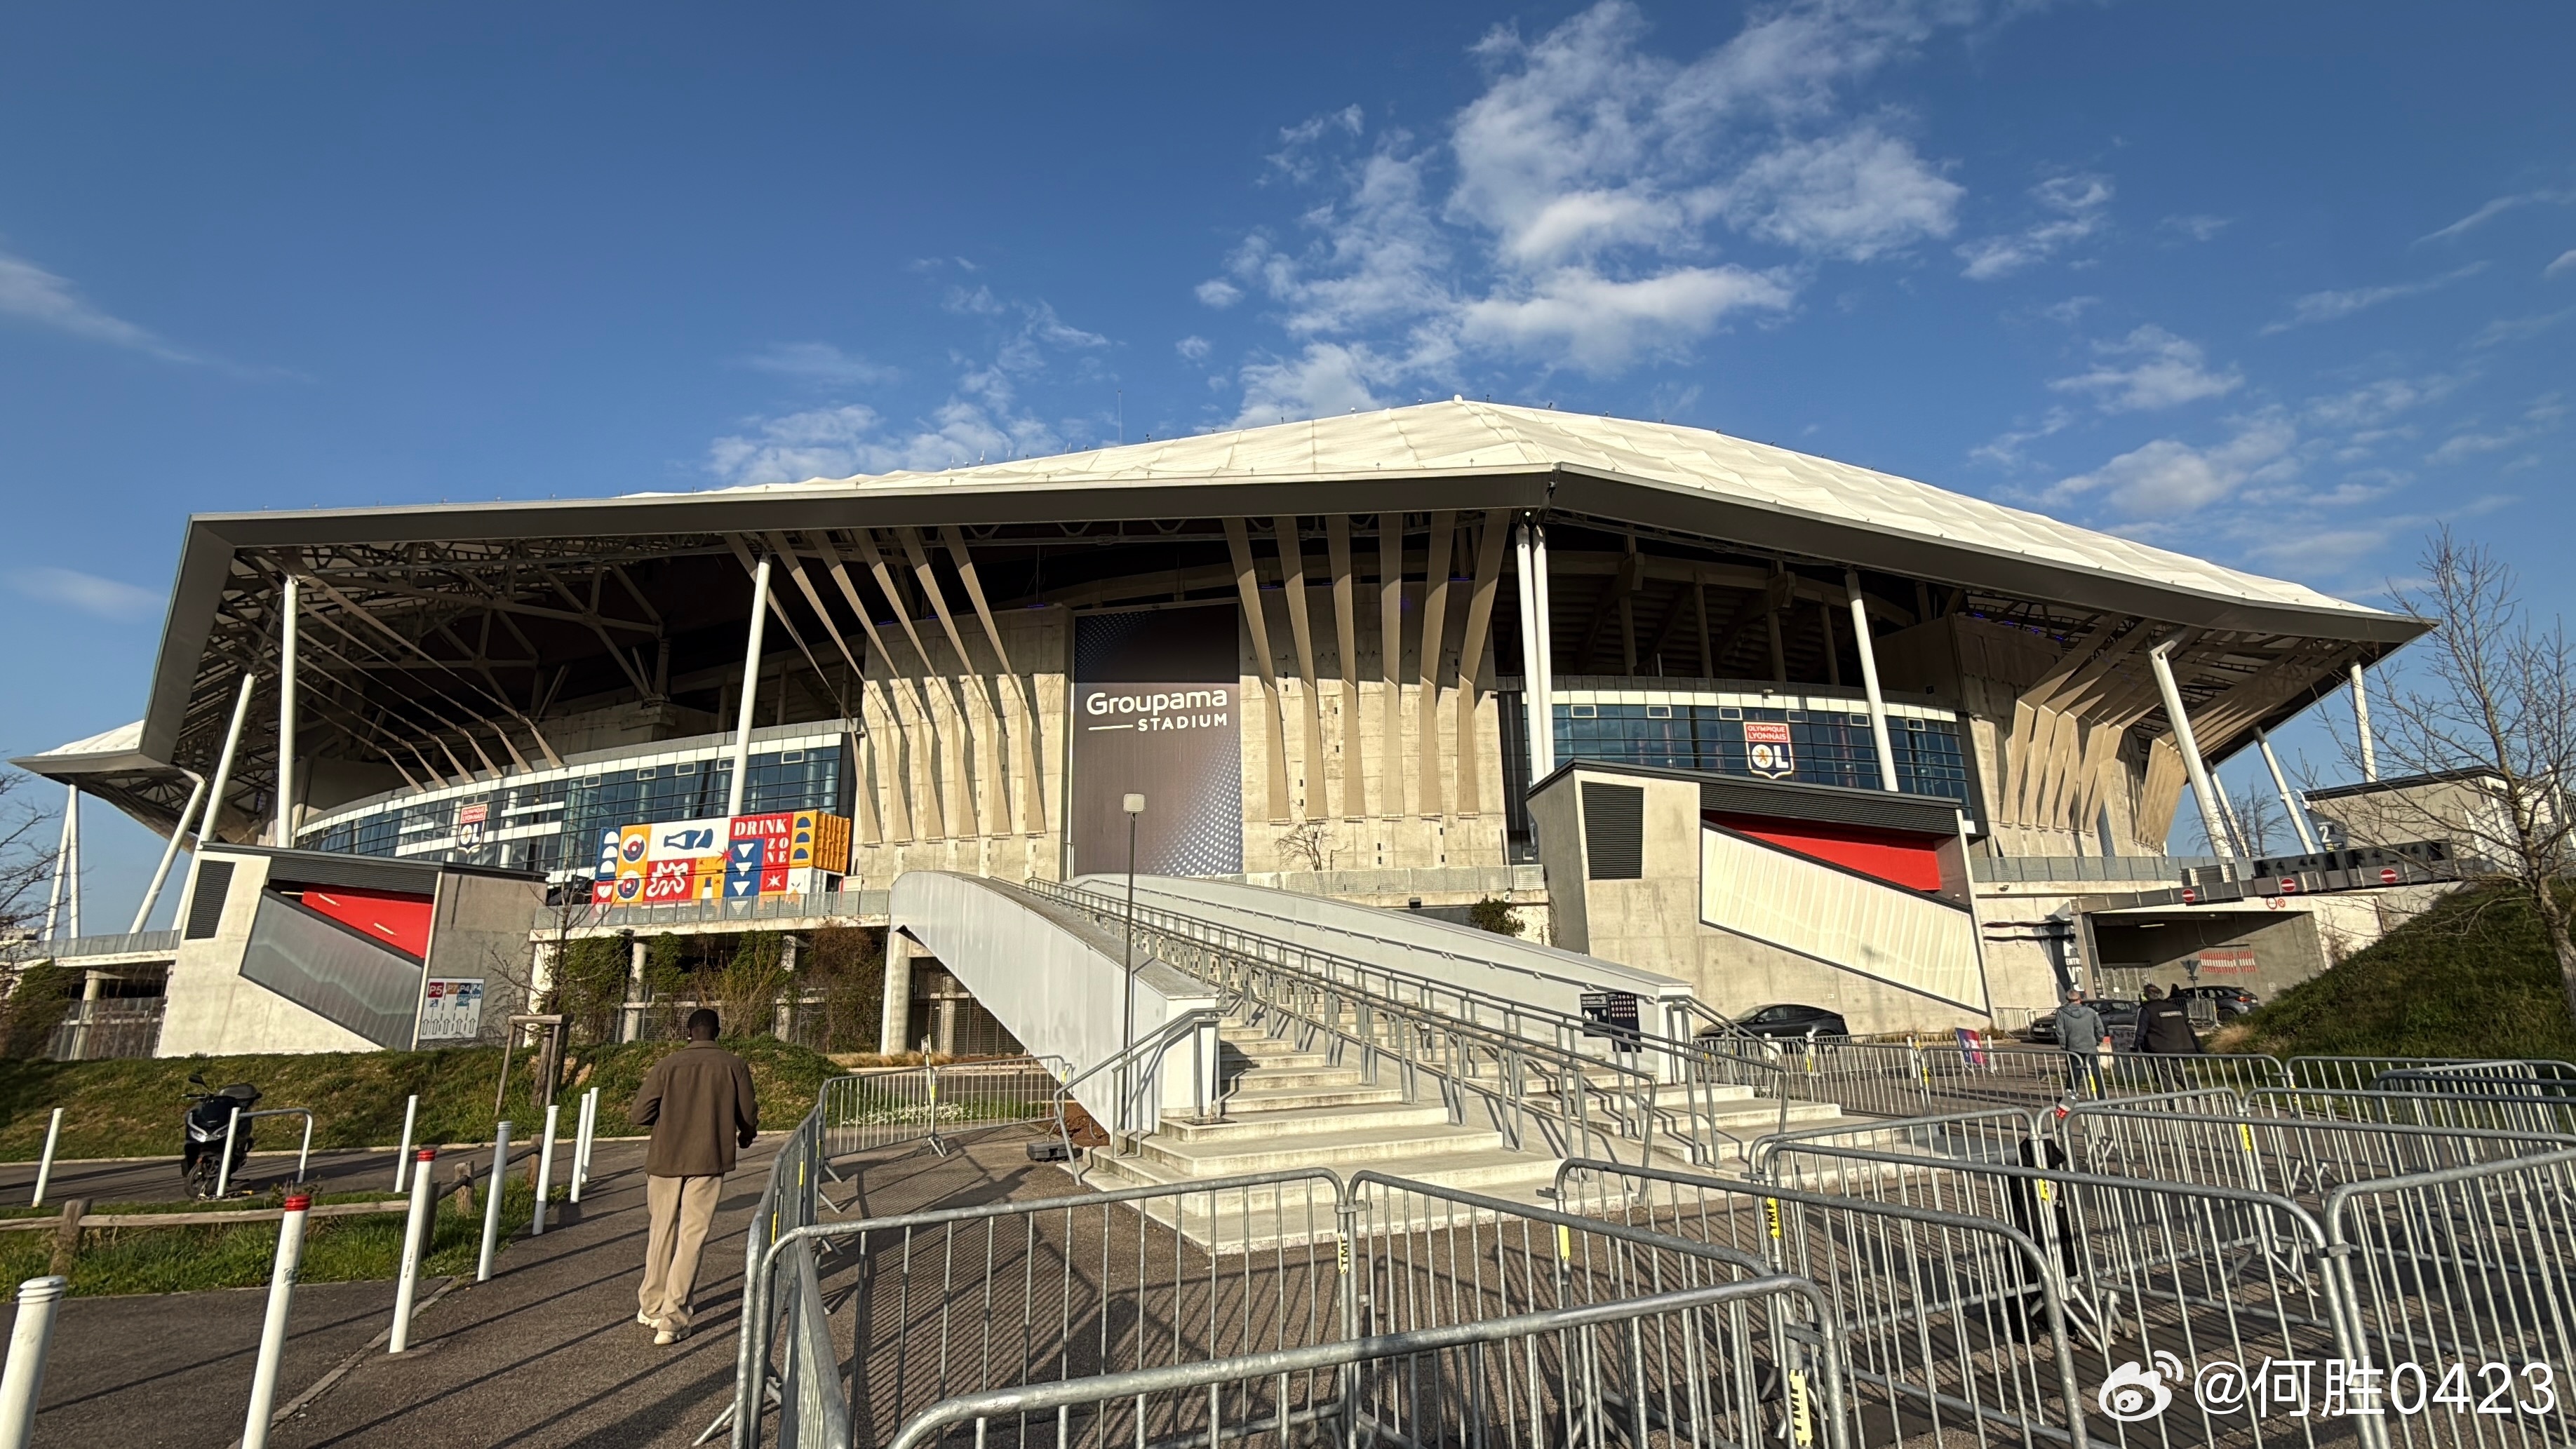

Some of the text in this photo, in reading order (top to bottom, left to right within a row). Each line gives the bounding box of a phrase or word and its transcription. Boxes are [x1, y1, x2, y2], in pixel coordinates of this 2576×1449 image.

[1087, 689, 1227, 715] Groupama
[1138, 713, 1227, 732] STADIUM
[1748, 732, 1787, 740] LYONNAIS
[1752, 744, 1789, 768] OL
[460, 823, 479, 844] OL
[734, 818, 787, 836] DRINK
[2319, 825, 2331, 842] 2
[429, 985, 443, 995] P5
[1340, 1236, 1348, 1267] TMF
